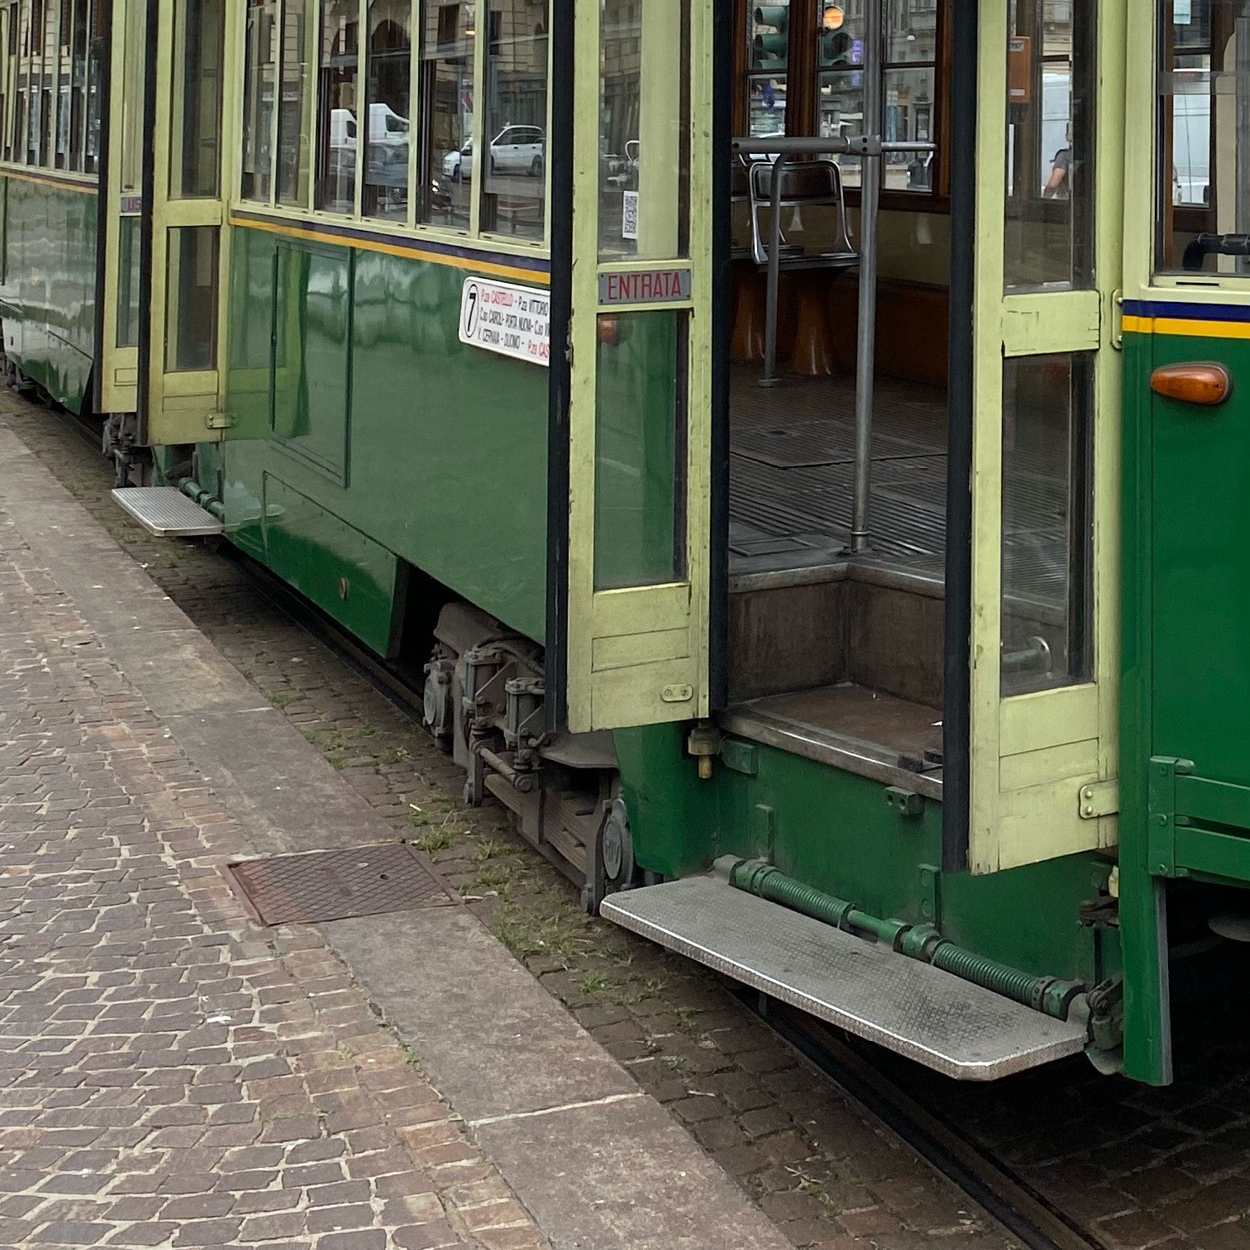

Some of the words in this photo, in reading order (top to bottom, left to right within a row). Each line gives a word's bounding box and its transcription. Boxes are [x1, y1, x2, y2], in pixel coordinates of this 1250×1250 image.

[128, 198, 142, 211] US
[608, 272, 682, 300] ENTRATA
[469, 292, 476, 332] 7
